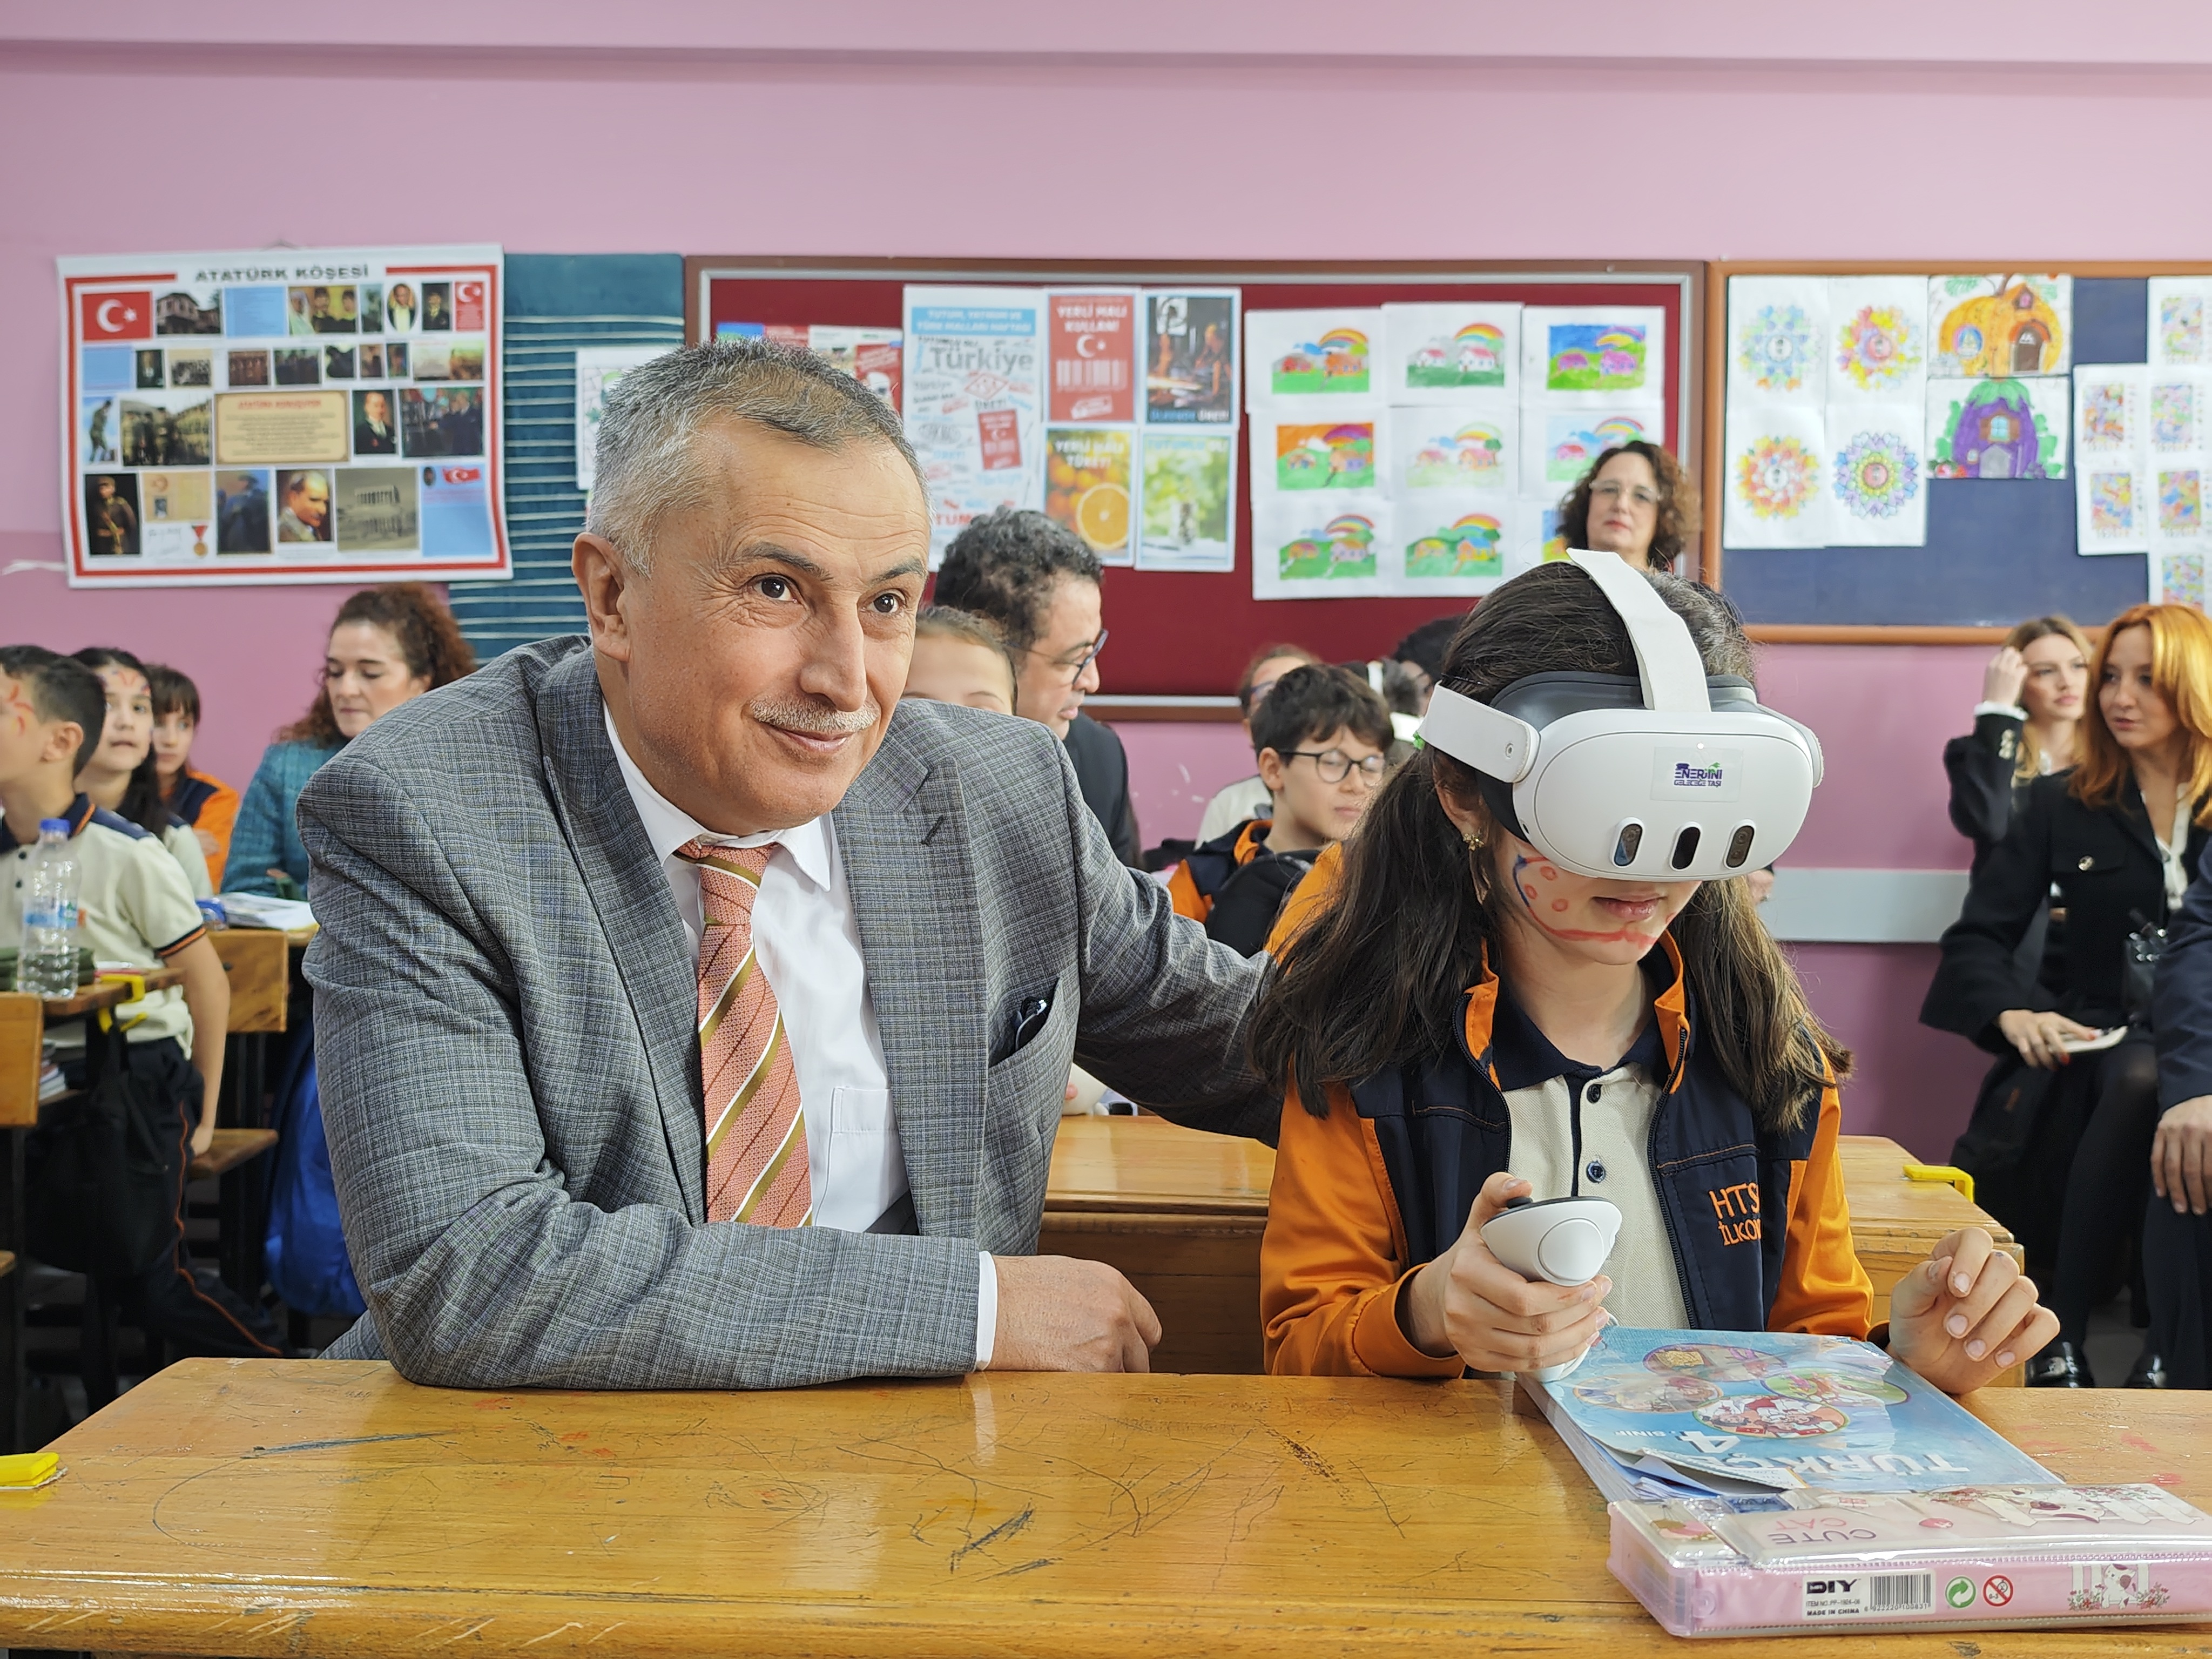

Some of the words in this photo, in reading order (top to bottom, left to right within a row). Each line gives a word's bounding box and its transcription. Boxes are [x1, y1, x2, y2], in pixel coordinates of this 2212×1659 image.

[196, 266, 288, 282] ATATÜRK
[295, 264, 369, 282] KÖŞESİ
[1057, 304, 1094, 318] YERLİ
[929, 347, 1034, 376] Türkiye
[1055, 437, 1090, 453] YERLİ
[1776, 1518, 1847, 1530] CAT
[1768, 1528, 1877, 1544] CUTE
[1806, 1579, 1858, 1595] DIY
